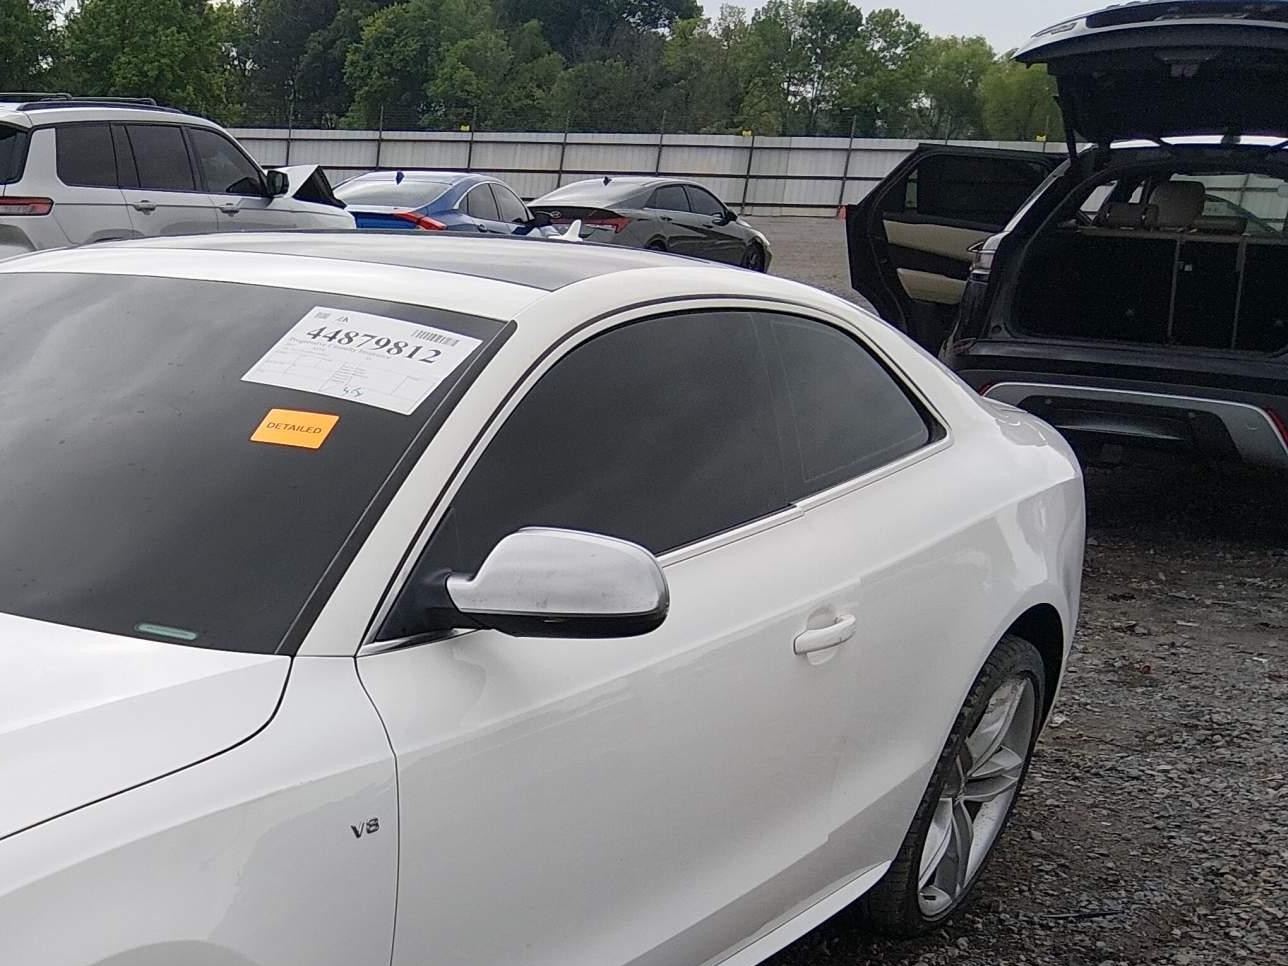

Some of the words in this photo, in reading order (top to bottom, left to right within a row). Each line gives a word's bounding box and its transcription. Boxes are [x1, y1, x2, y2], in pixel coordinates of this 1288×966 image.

[306, 326, 442, 364] 44879812
[266, 422, 322, 434] DETAILED
[350, 817, 380, 839] V8
